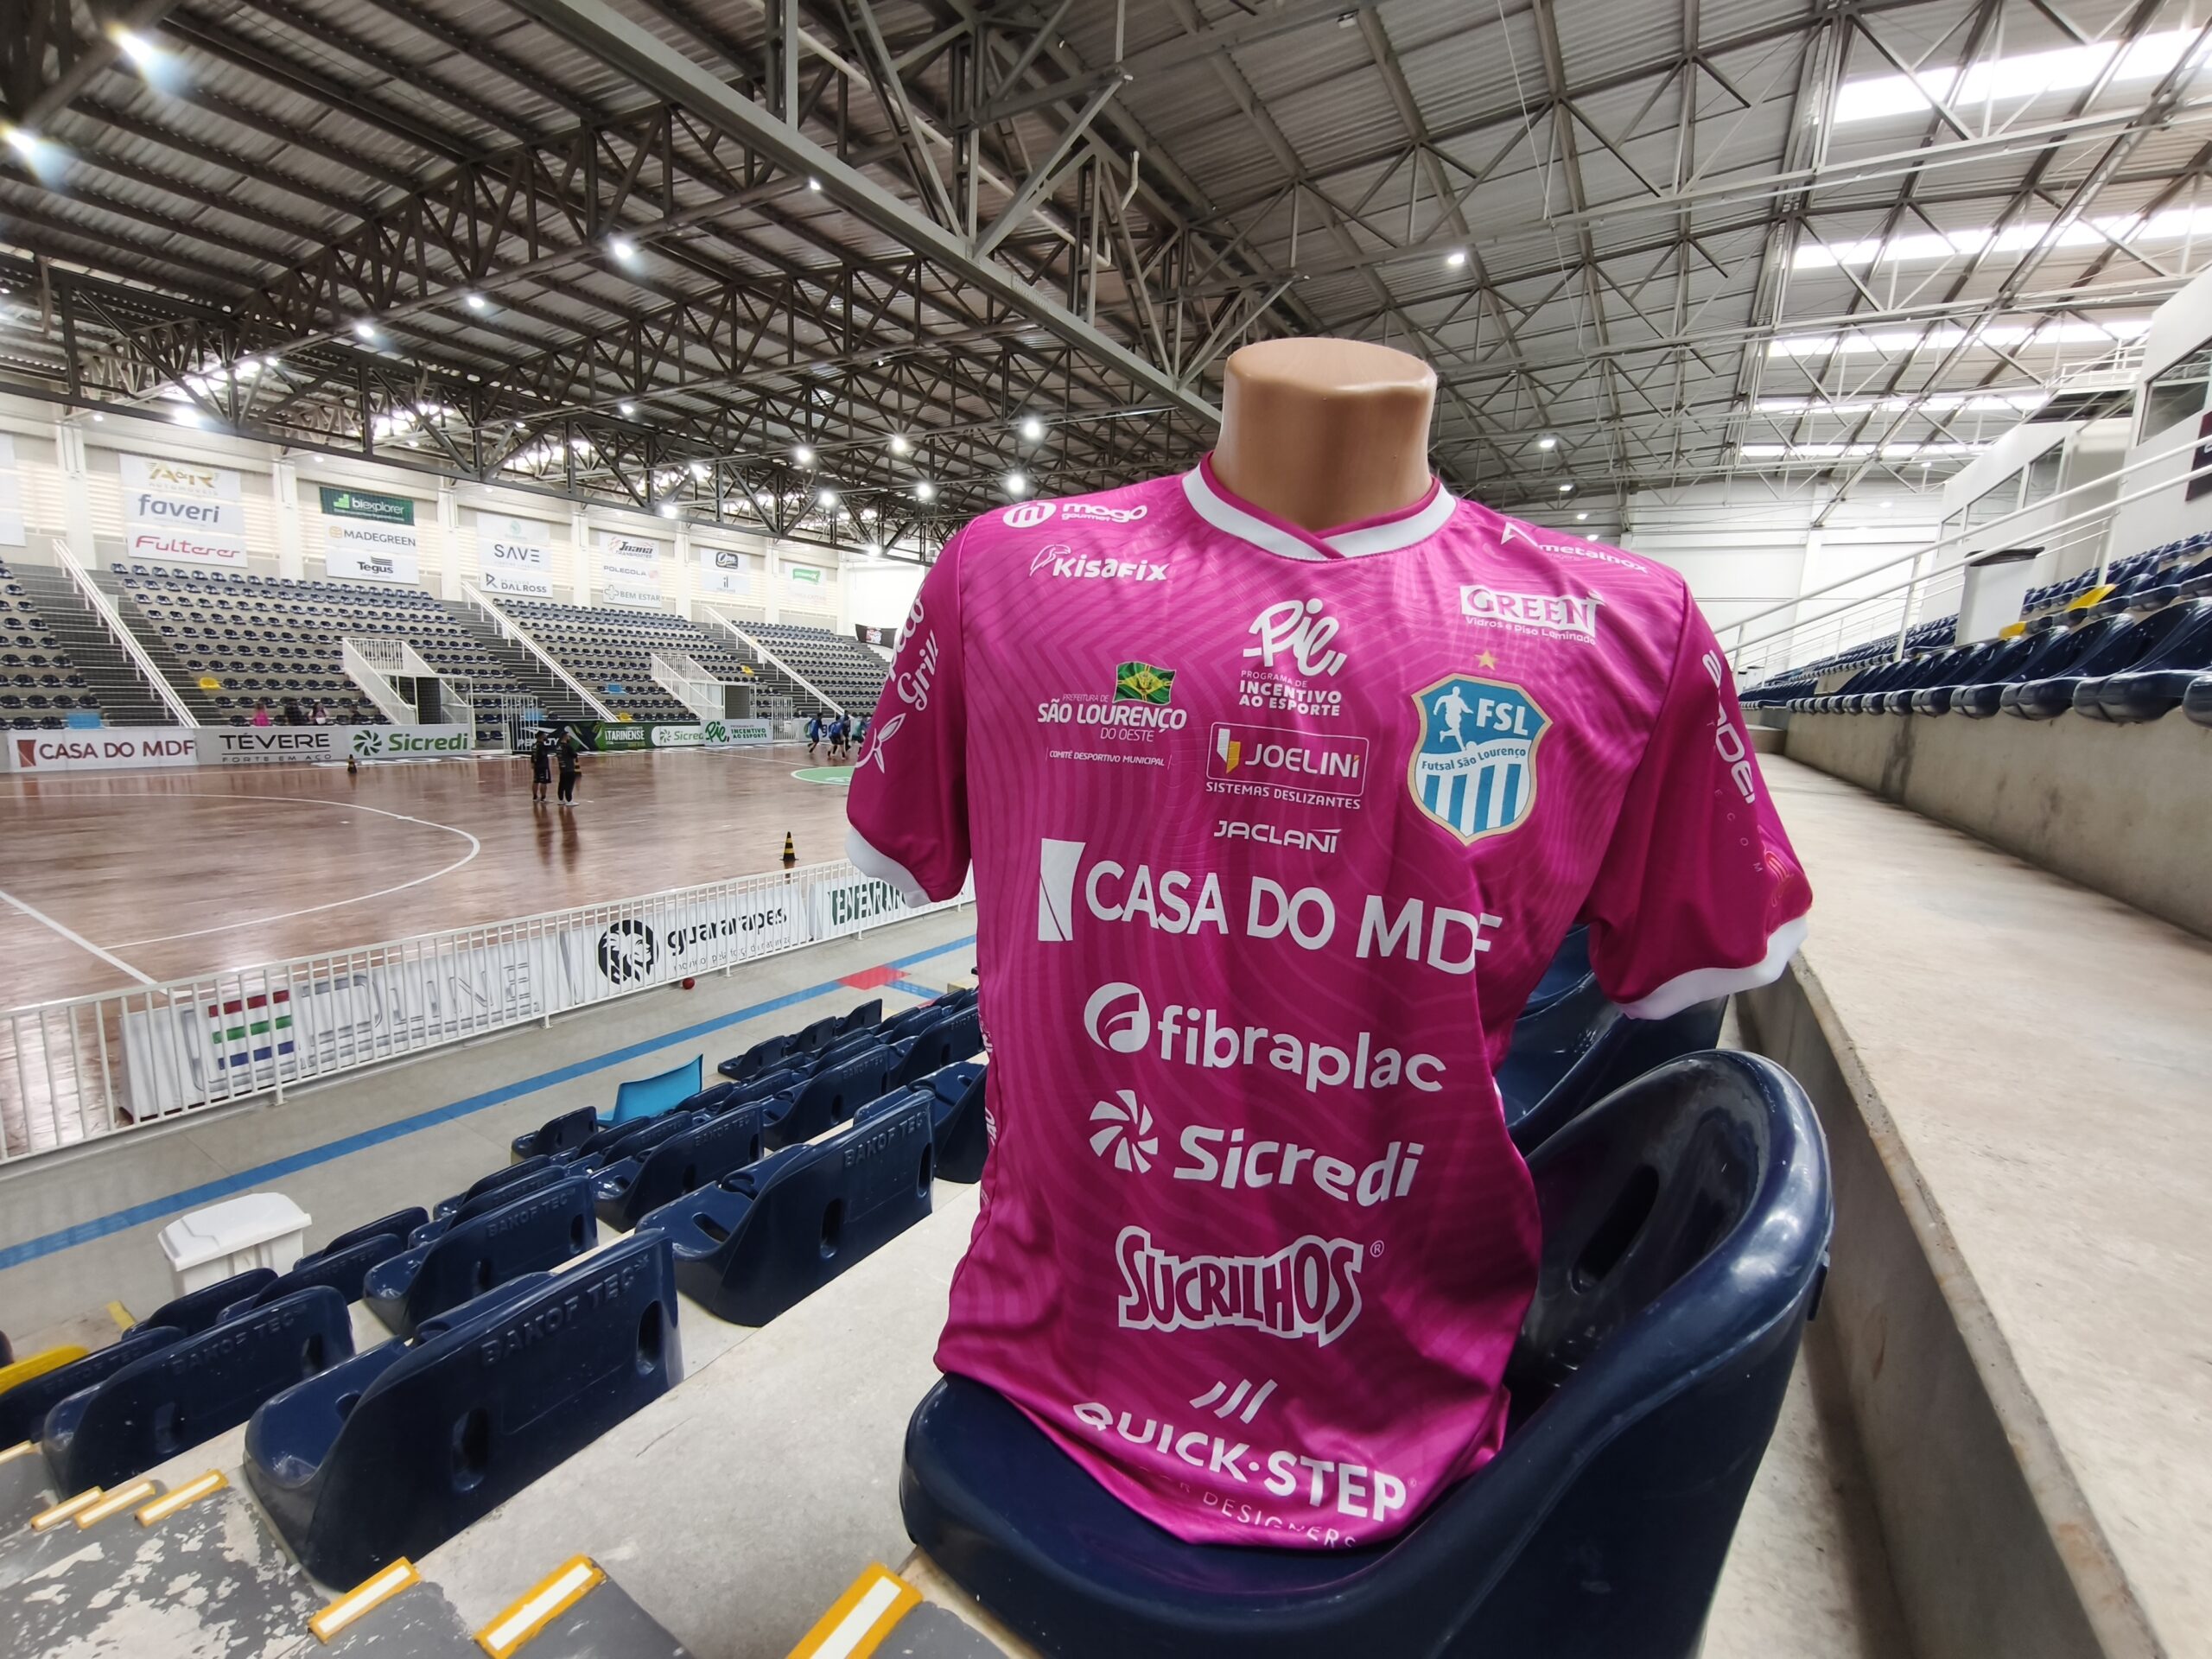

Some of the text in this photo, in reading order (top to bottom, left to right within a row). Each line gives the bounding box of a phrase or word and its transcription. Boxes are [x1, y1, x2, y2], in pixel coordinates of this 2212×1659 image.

[138, 494, 219, 523] faveri
[352, 498, 404, 515] biexplorer
[1063, 503, 1147, 523] mogo
[136, 536, 240, 558] Fulterer
[344, 530, 416, 546] MADEGREEN
[494, 543, 540, 563] SAVE
[357, 562, 393, 574] Tegus
[604, 566, 646, 576] POLECOLA
[1466, 588, 1592, 631] GREEN
[1465, 616, 1503, 628] Vidros
[1514, 625, 1538, 636] Piso
[1541, 629, 1597, 645] Laminado
[1241, 671, 1292, 684] PROGRAMA
[1239, 680, 1342, 704] INCENTIVO
[1038, 698, 1186, 733] SÃO LOURENÇO
[1239, 694, 1340, 716] AO ESPORTE
[1476, 698, 1528, 735] FSL
[219, 733, 330, 750] TÉVERE
[389, 733, 467, 751] Sicredi
[1100, 728, 1154, 742] DO OESTE
[39, 740, 195, 760] CASA DO MDF
[1074, 752, 1120, 762] DESPORTIVO
[1122, 755, 1165, 766] MUNICIPAL
[1421, 747, 1527, 771] Futsal São Lourenço
[1206, 782, 1361, 810] SISTEMAS DESLIZANTES
[1086, 860, 1503, 975] CASA DO MDF
[1158, 1004, 1446, 1092] fibraplac
[1173, 1125, 1424, 1207] Sicredi
[1117, 1228, 1362, 1344] SUCRILHOS
[481, 1267, 635, 1367] BAKOF TEC
